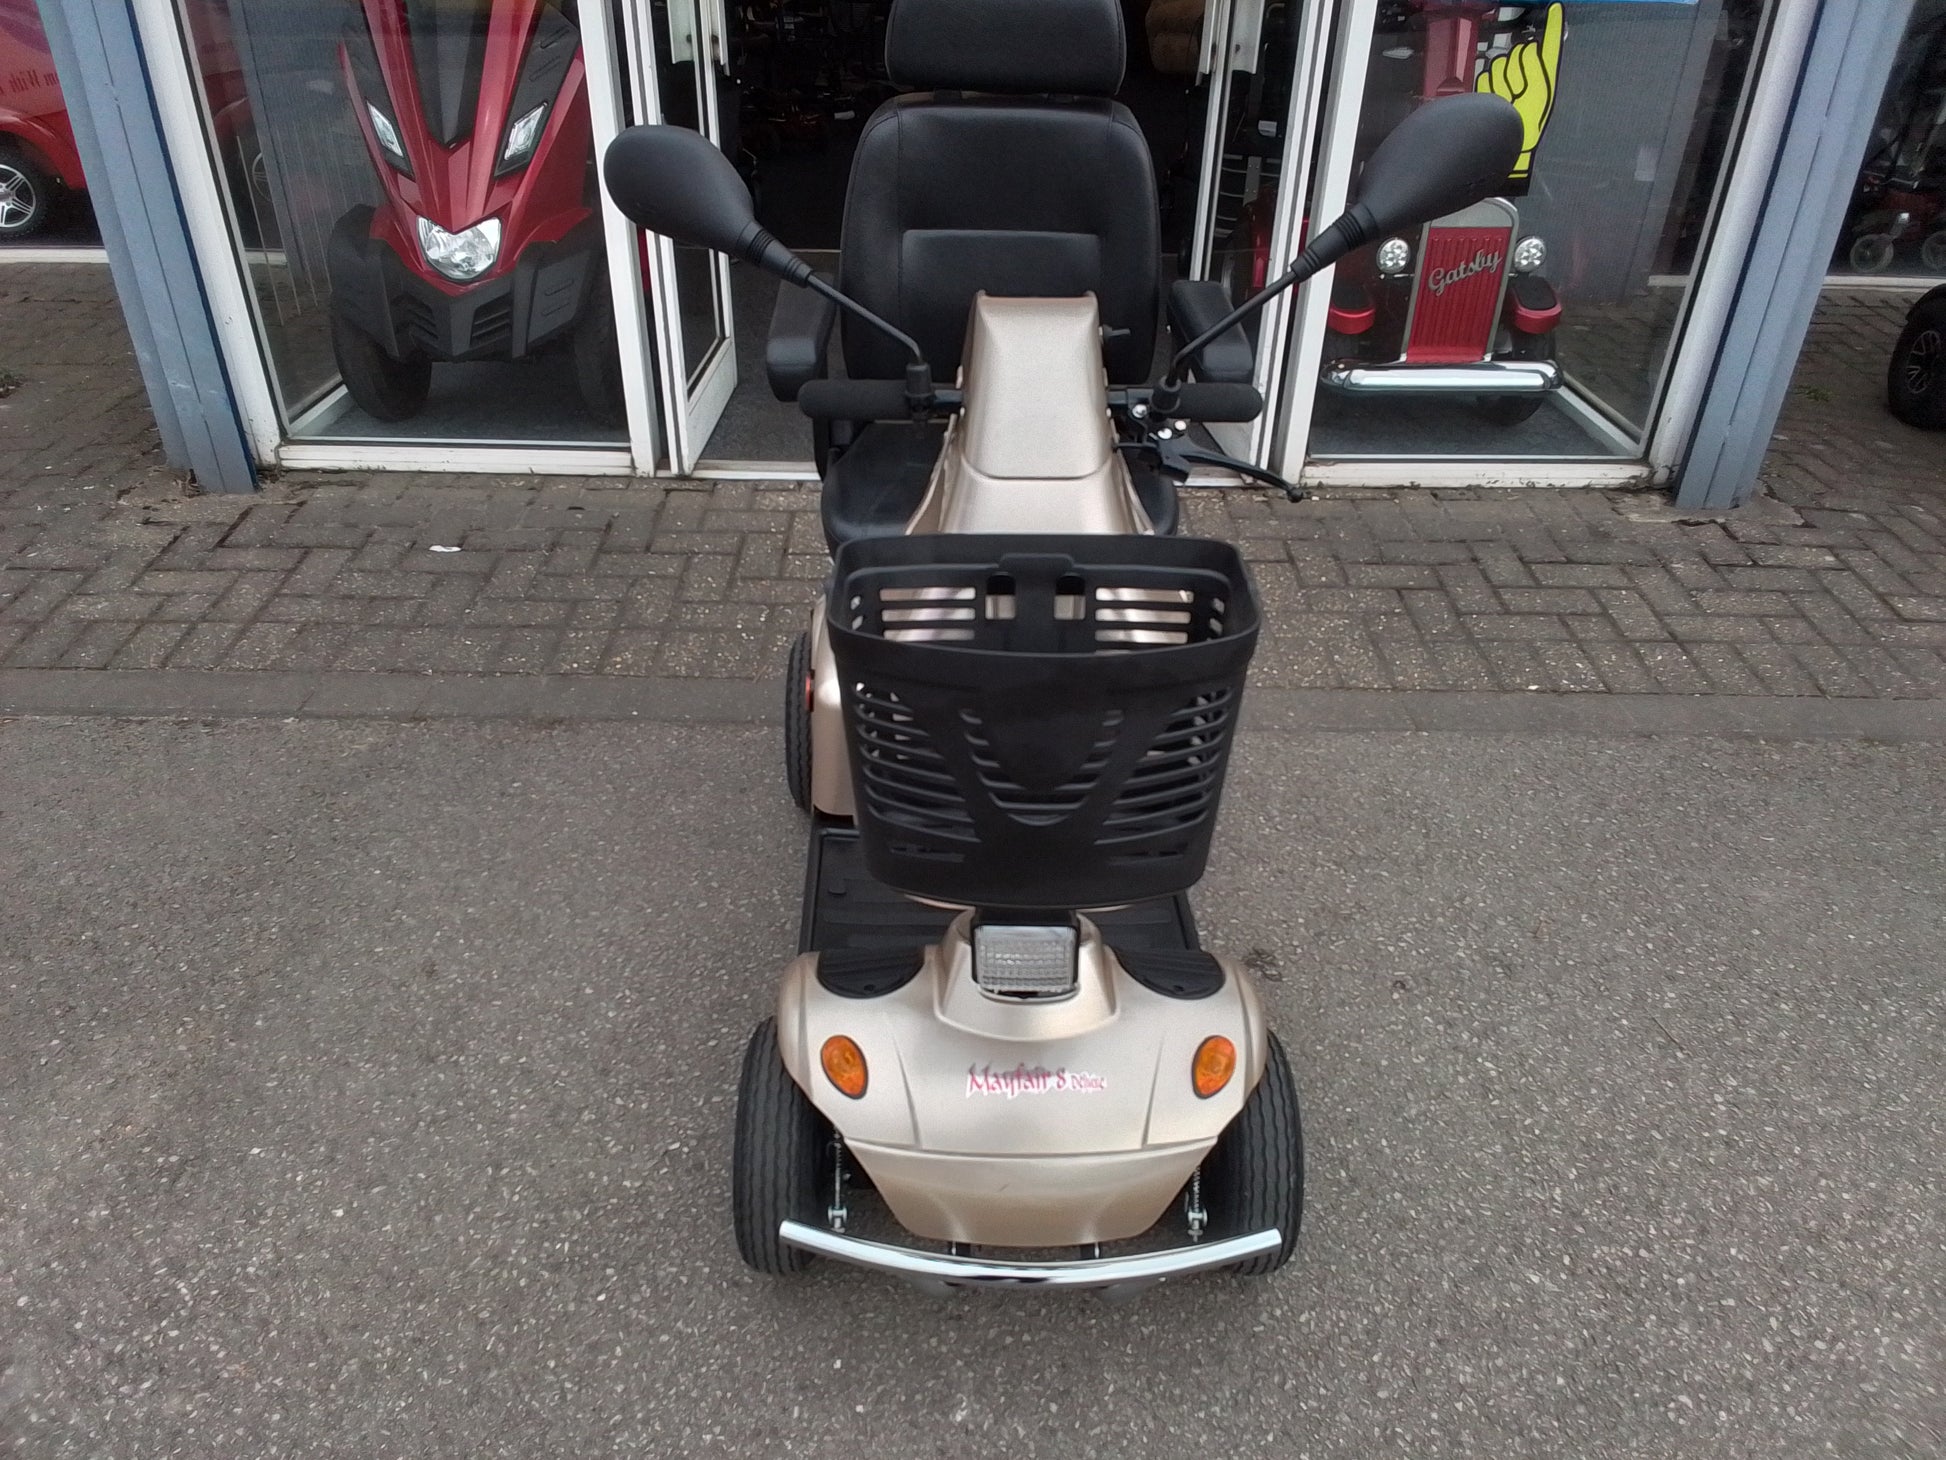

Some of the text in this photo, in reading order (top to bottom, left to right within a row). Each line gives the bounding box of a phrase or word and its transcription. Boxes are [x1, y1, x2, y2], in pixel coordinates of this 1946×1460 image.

[1428, 248, 1503, 297] Gatsby
[966, 1061, 1052, 1098] Mayfair
[1055, 1066, 1067, 1091] 8
